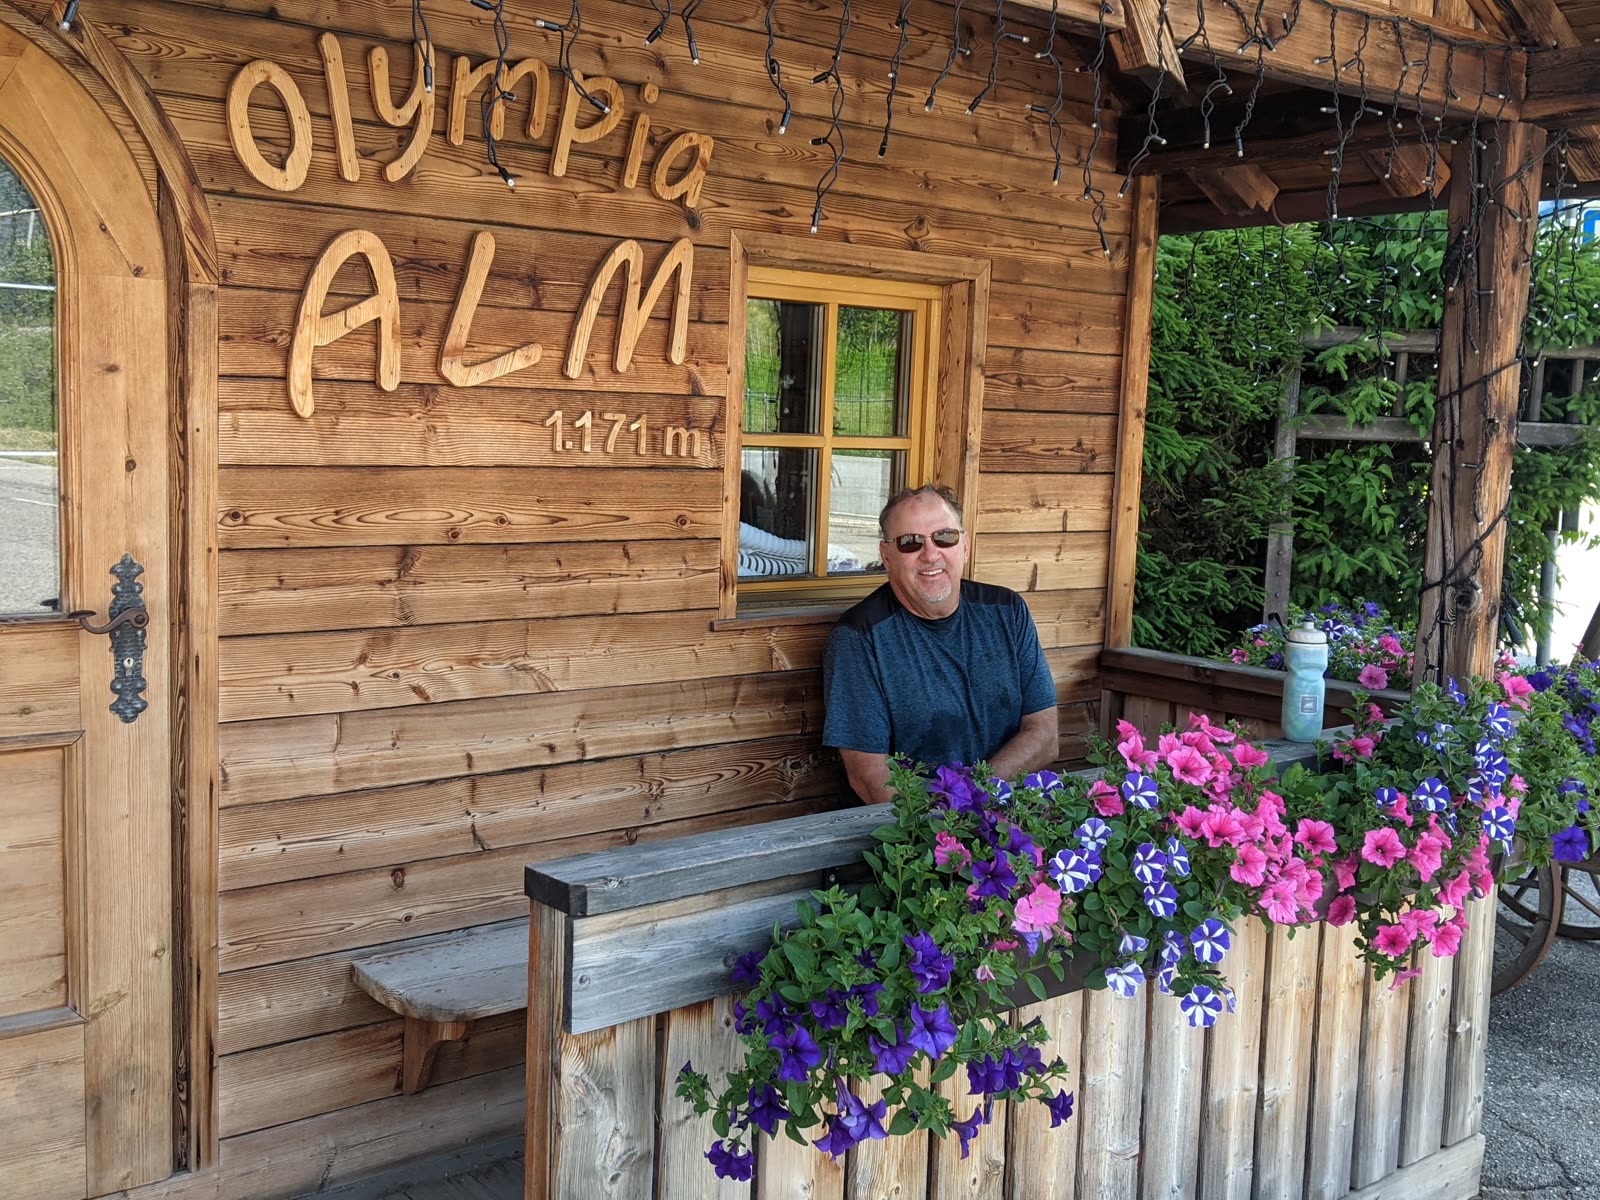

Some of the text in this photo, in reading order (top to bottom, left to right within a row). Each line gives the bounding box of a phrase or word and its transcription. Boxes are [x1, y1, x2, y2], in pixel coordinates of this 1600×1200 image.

[287, 230, 695, 418] ALM
[543, 410, 702, 457] 1.171 m
